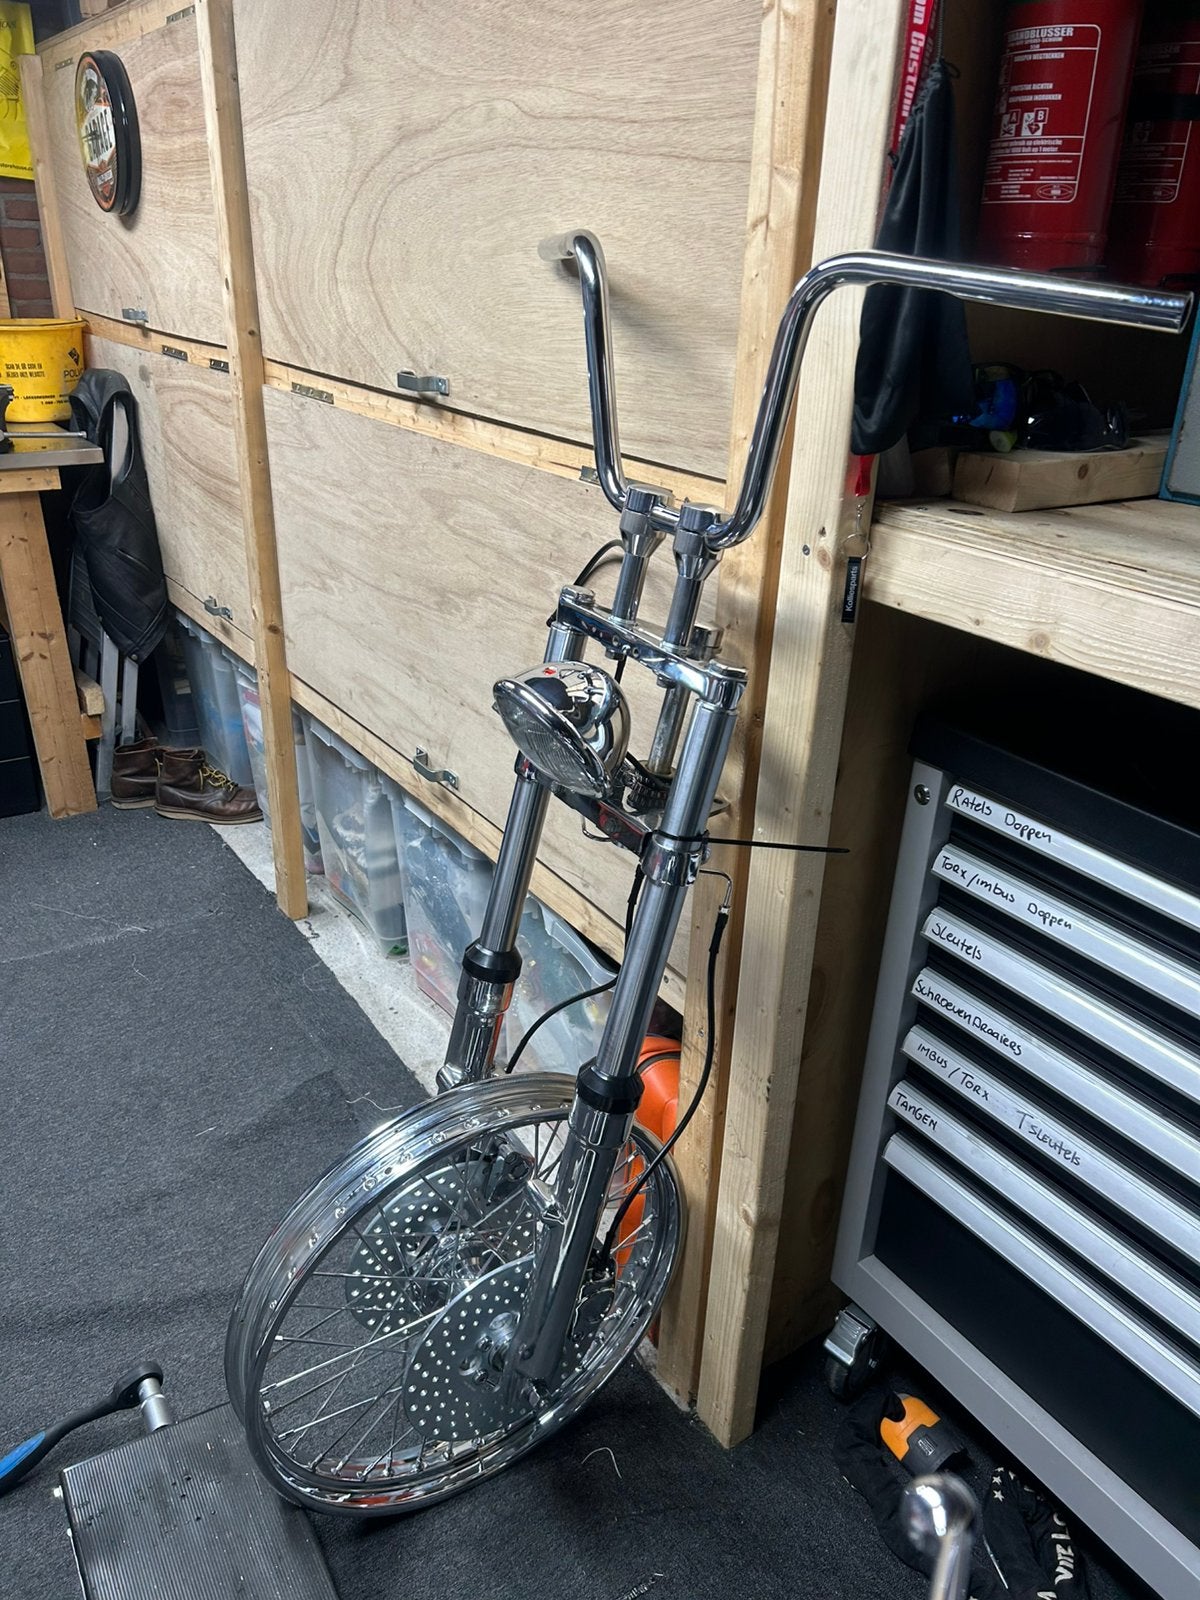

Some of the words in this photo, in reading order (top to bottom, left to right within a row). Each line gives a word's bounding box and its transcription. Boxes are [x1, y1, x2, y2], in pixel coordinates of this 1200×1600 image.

[901, 31, 926, 117] Custom
[1037, 110, 1045, 120] B
[1004, 812, 1052, 844] Doppen
[1026, 902, 1072, 930] Doppen
